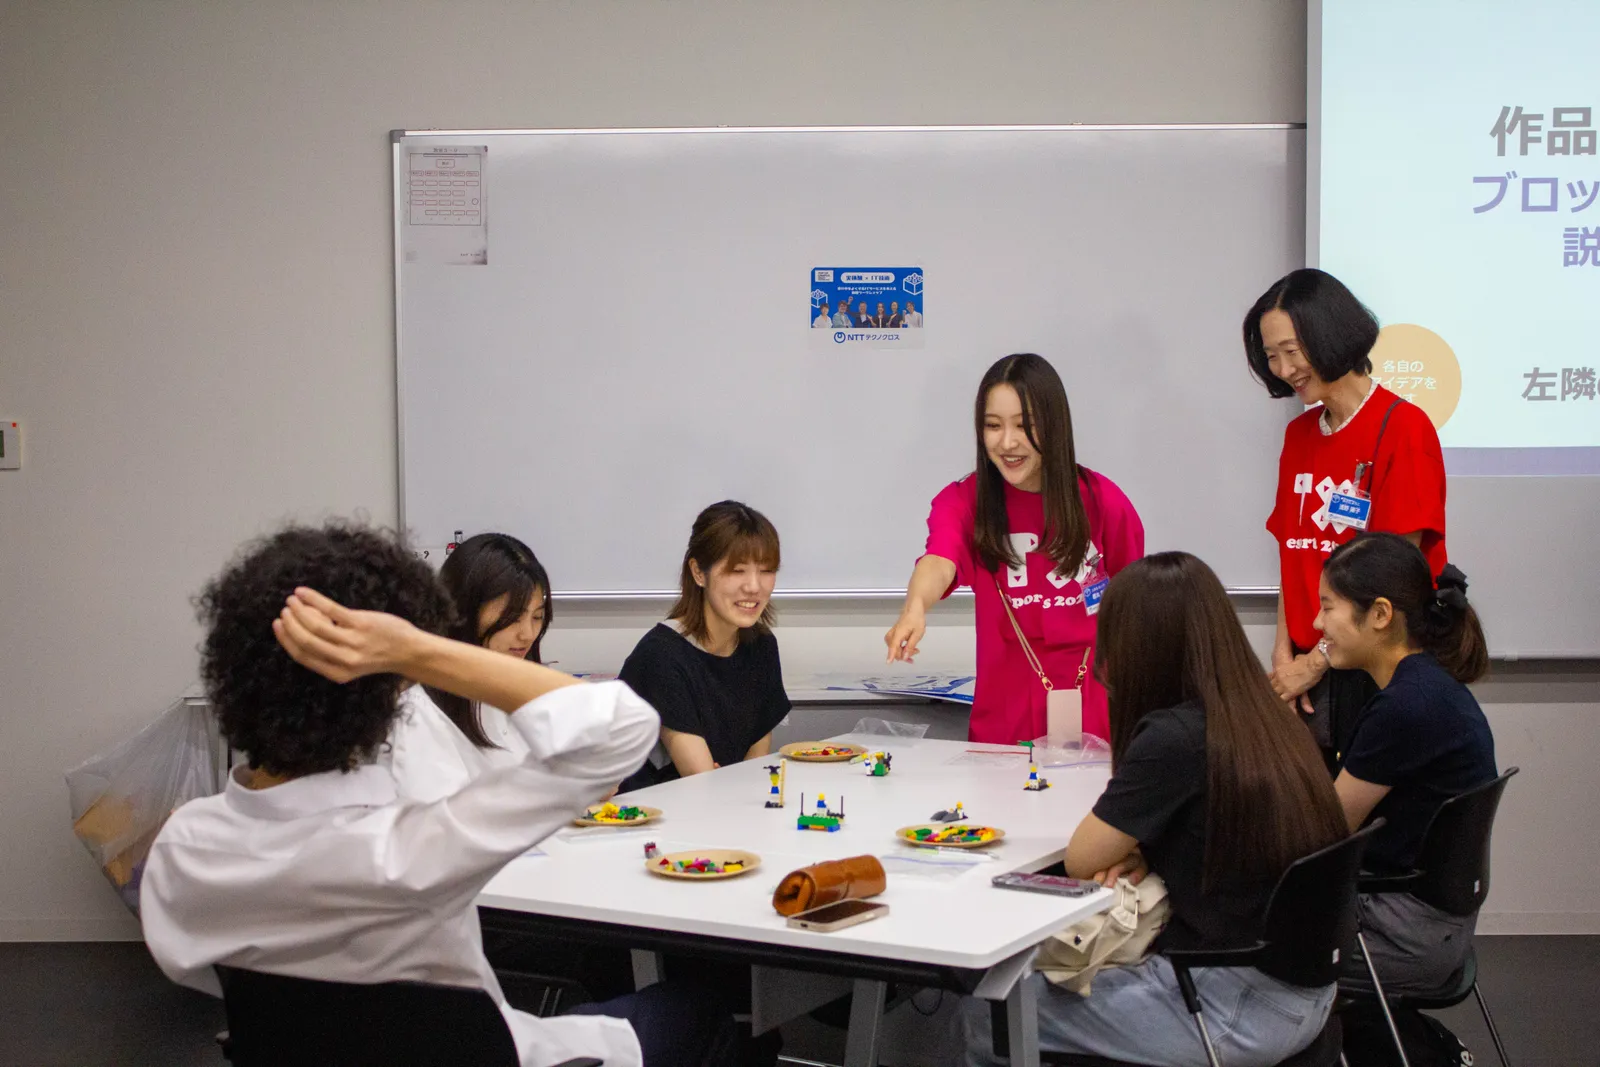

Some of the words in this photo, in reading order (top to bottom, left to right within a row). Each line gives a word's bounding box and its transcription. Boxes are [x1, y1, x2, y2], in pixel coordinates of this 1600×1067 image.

[1489, 105, 1597, 157] 作品
[1472, 170, 1600, 214] ブロッ
[1563, 226, 1600, 267] 説
[1382, 359, 1424, 373] 各自の
[1521, 366, 1600, 402] 左隣
